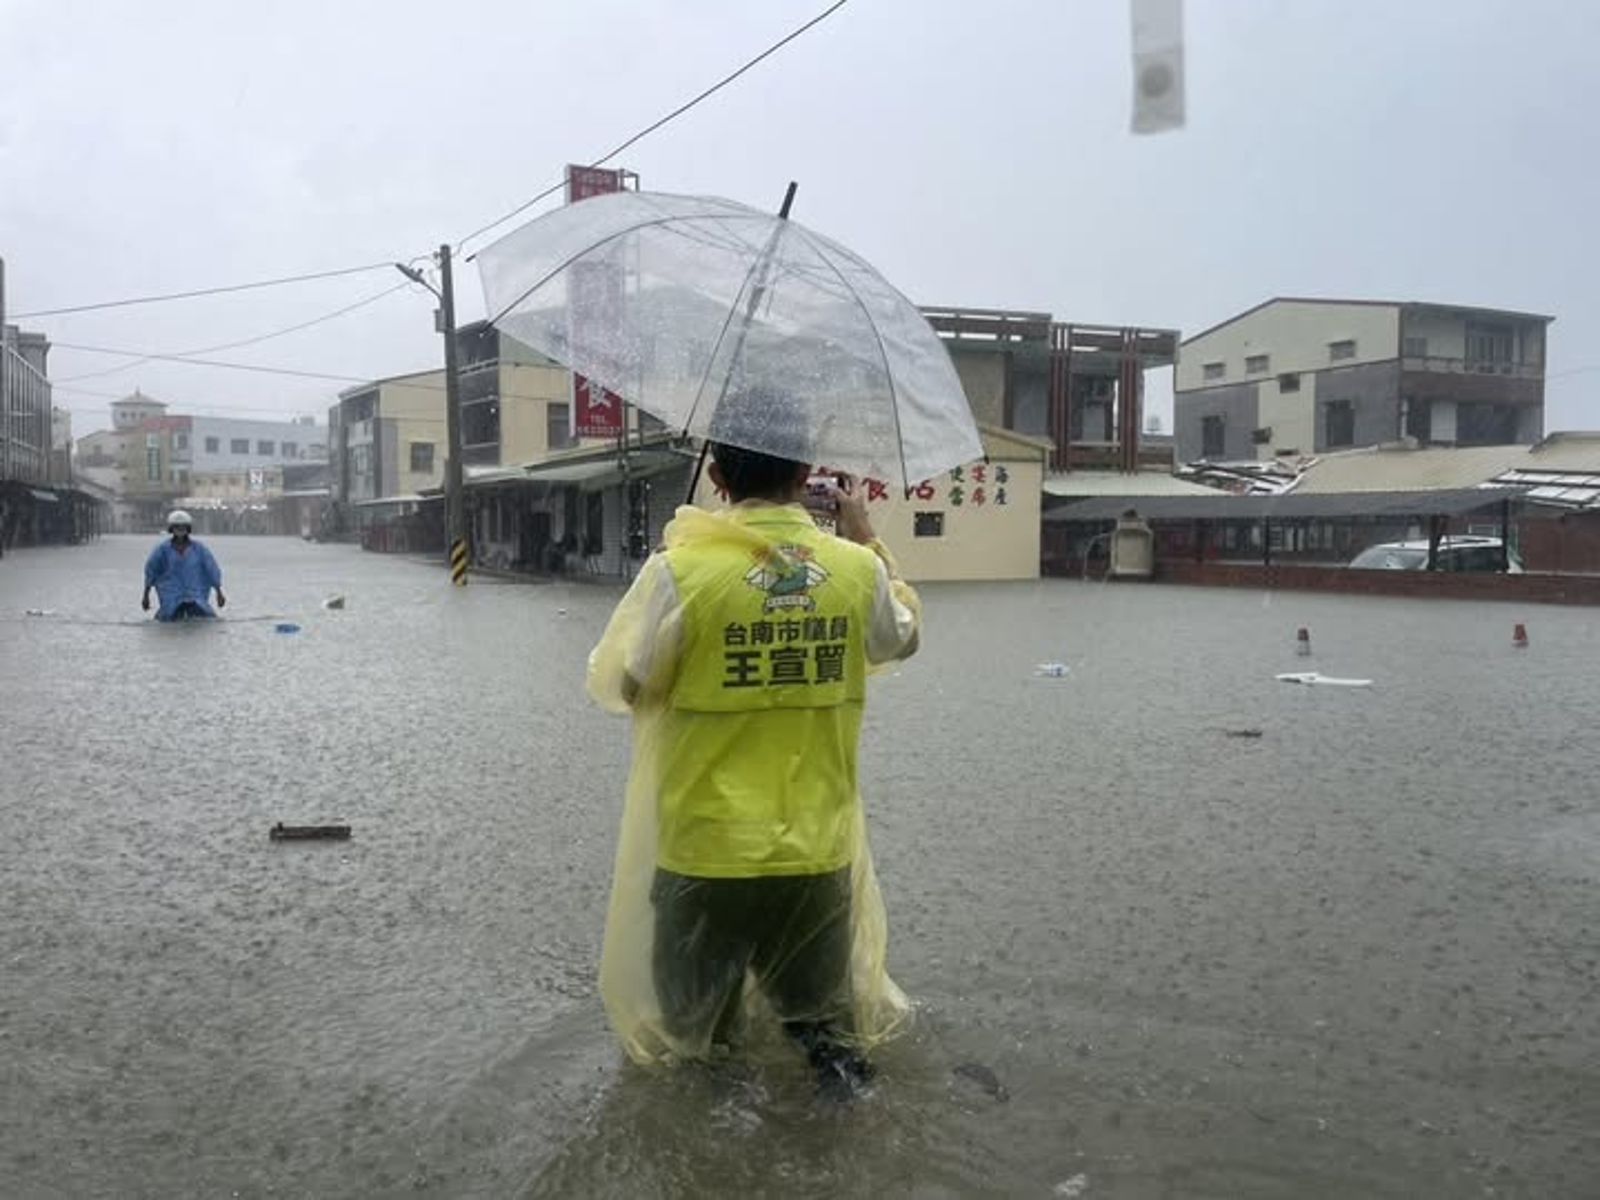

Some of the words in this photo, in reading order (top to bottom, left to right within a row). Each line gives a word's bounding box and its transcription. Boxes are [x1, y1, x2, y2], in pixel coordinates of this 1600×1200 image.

[723, 617, 848, 646] 台南市議員
